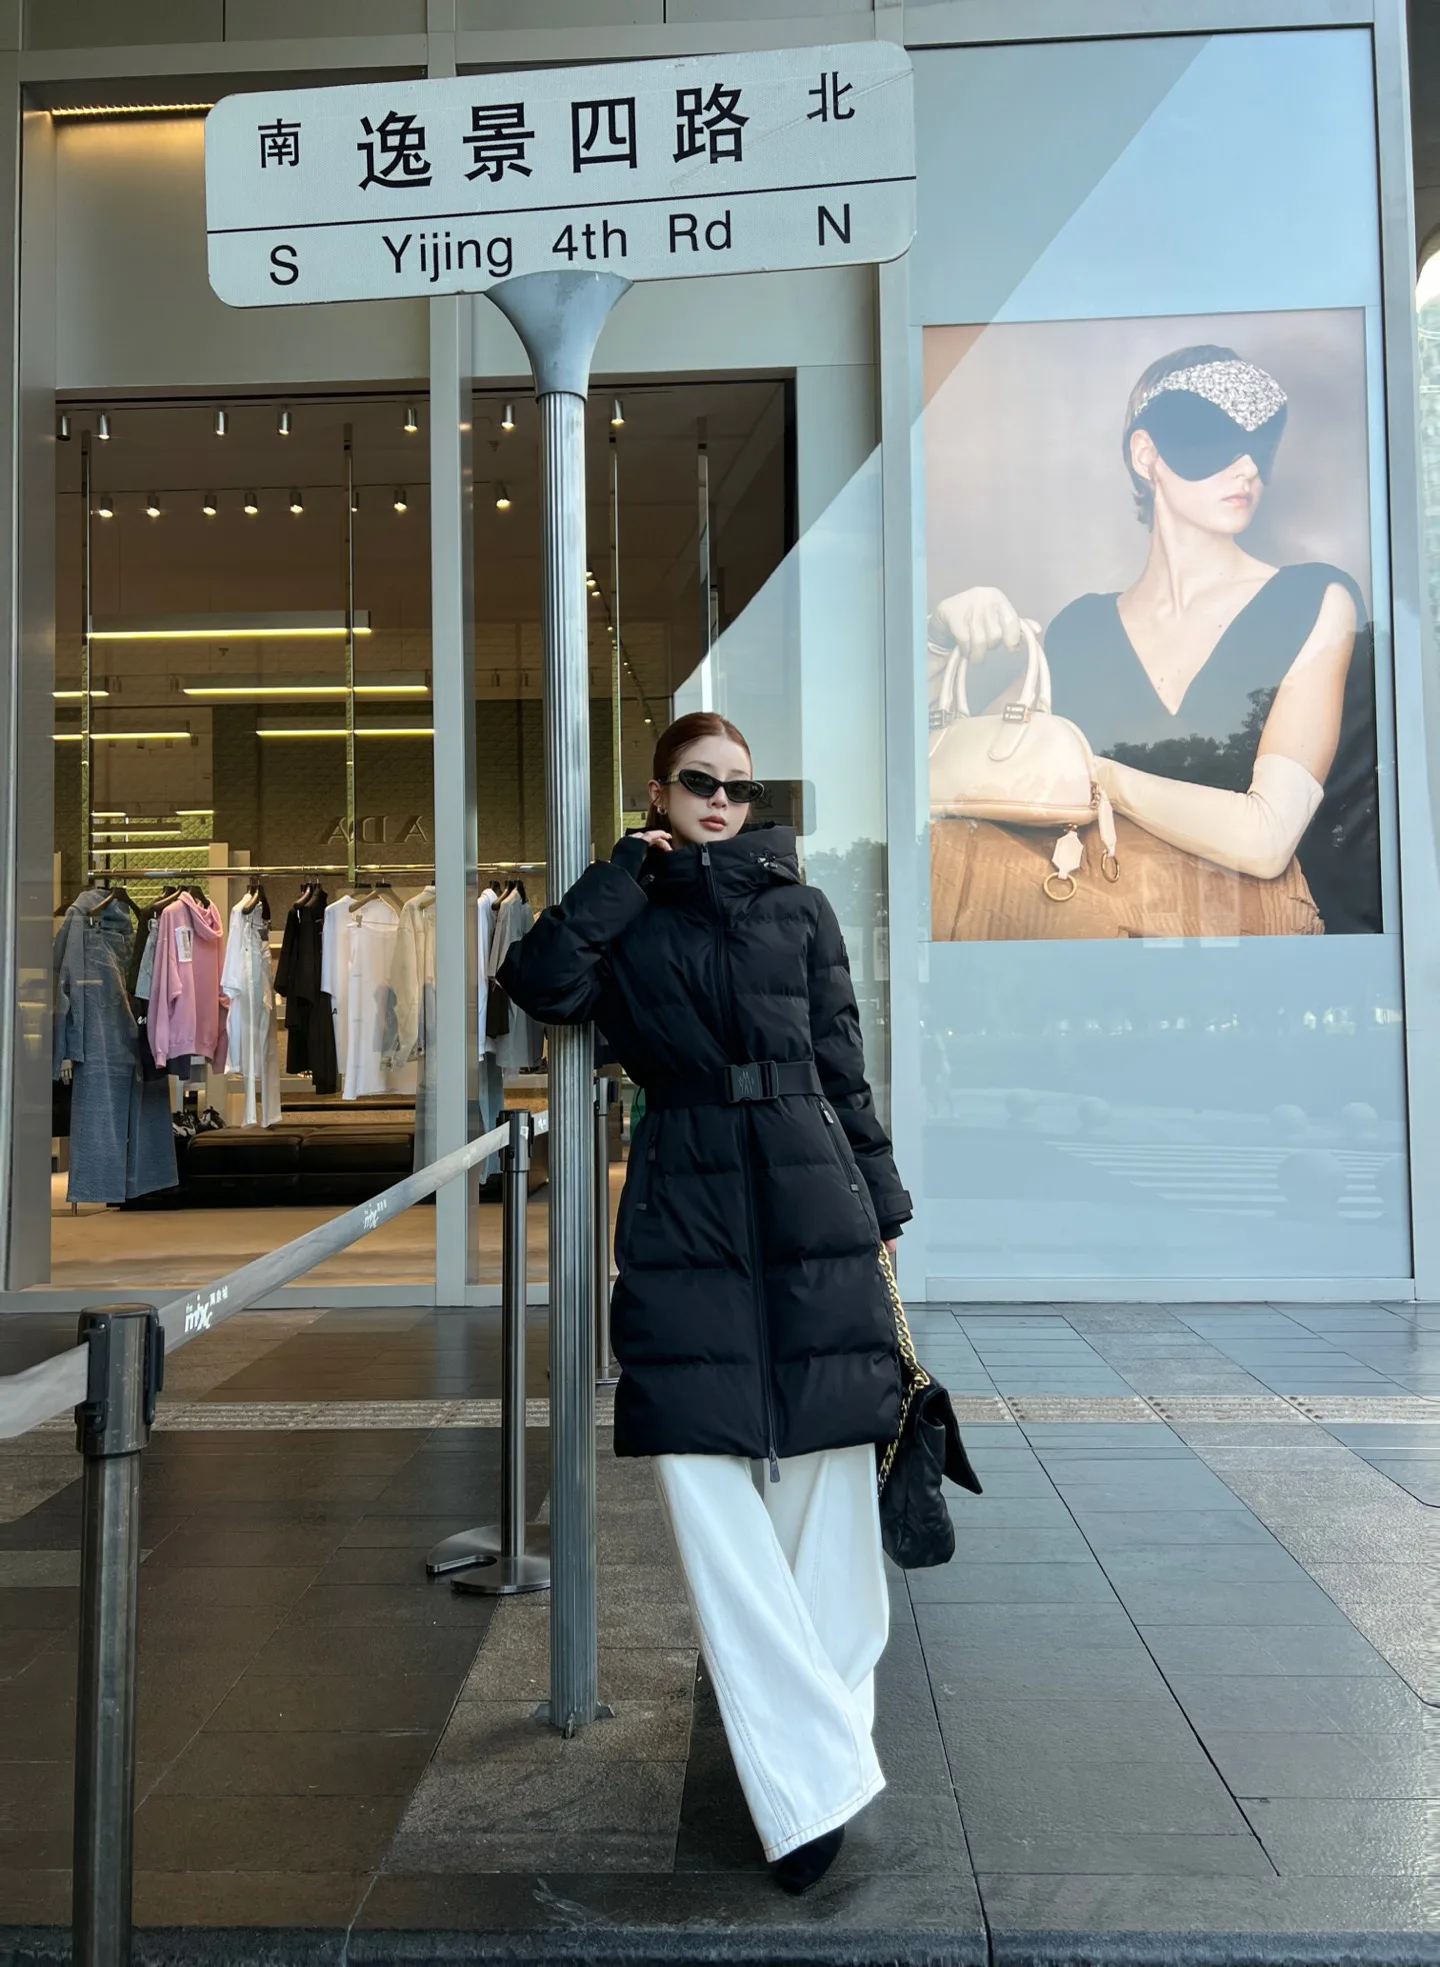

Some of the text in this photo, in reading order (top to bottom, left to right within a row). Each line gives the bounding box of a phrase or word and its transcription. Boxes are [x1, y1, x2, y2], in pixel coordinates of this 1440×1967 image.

[258, 71, 856, 191] 南 逸景四路 北
[269, 203, 852, 286] S Yijing 4th Rd N
